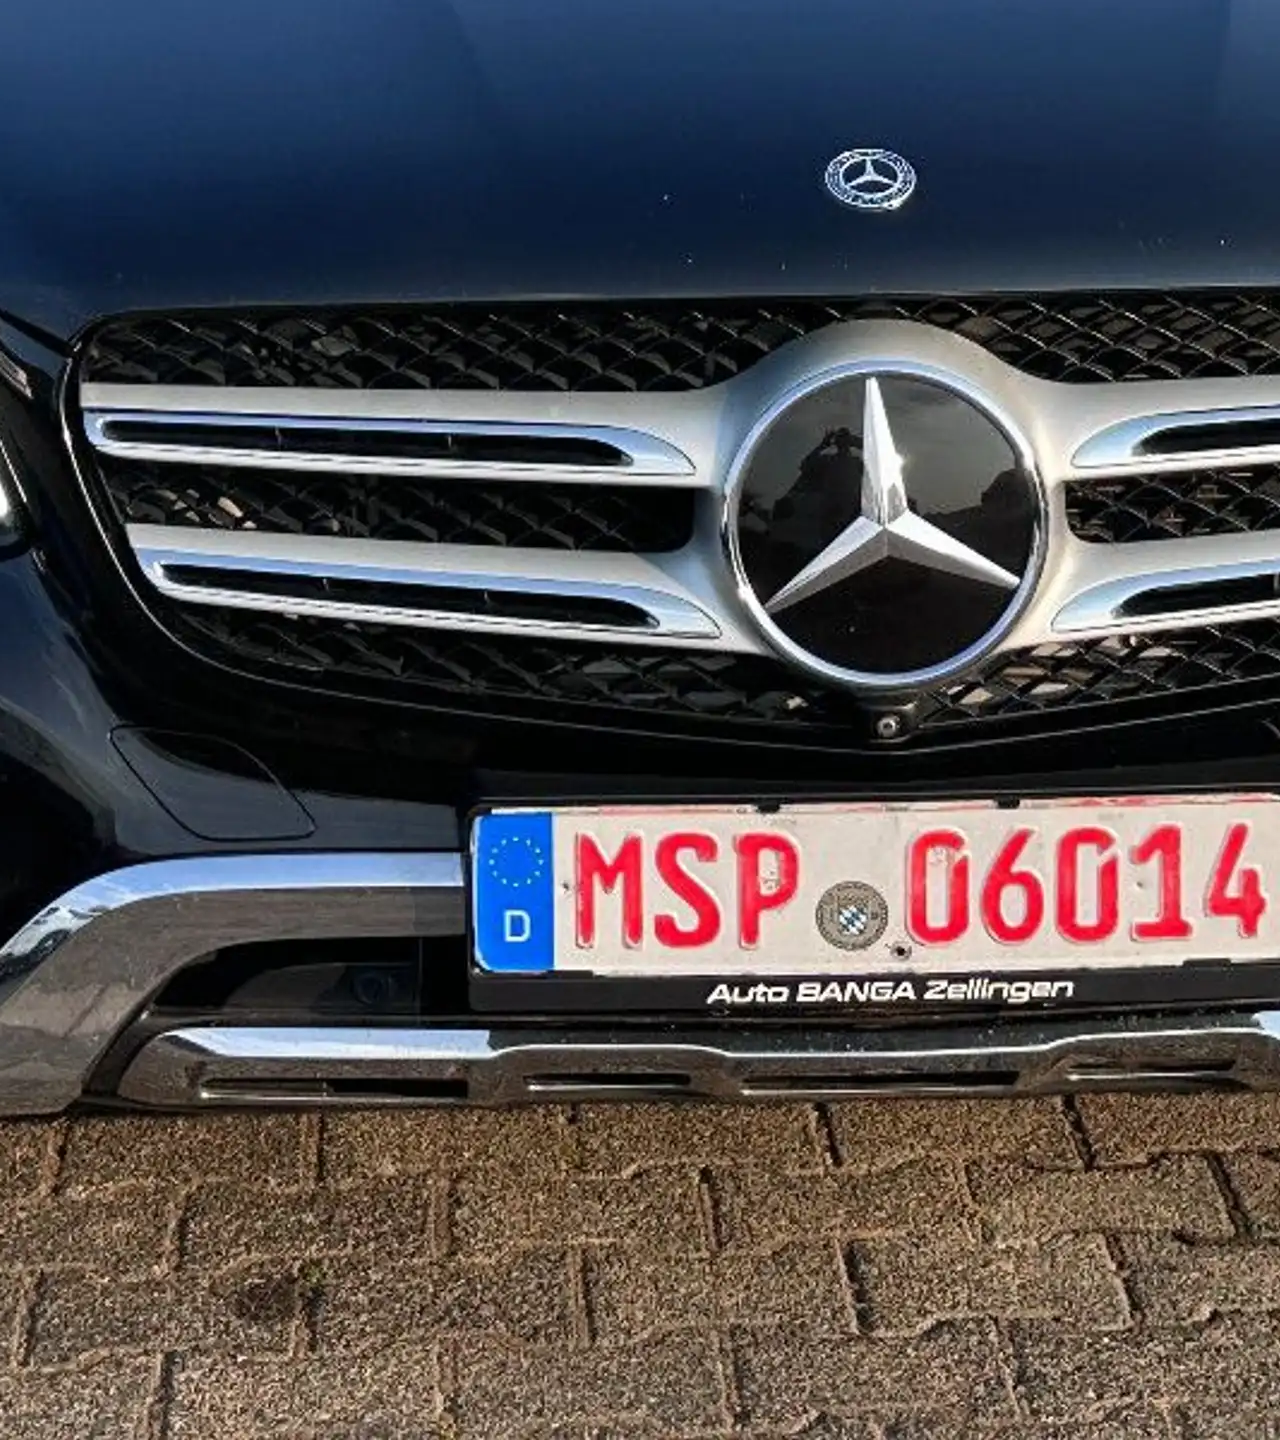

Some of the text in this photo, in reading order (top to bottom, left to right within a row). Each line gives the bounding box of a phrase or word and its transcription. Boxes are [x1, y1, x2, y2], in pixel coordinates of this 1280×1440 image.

[504, 909, 531, 942] D
[575, 830, 802, 950] MSP
[906, 821, 1267, 946] 06014
[706, 978, 1075, 1004] Auto BANGA Zellingen
